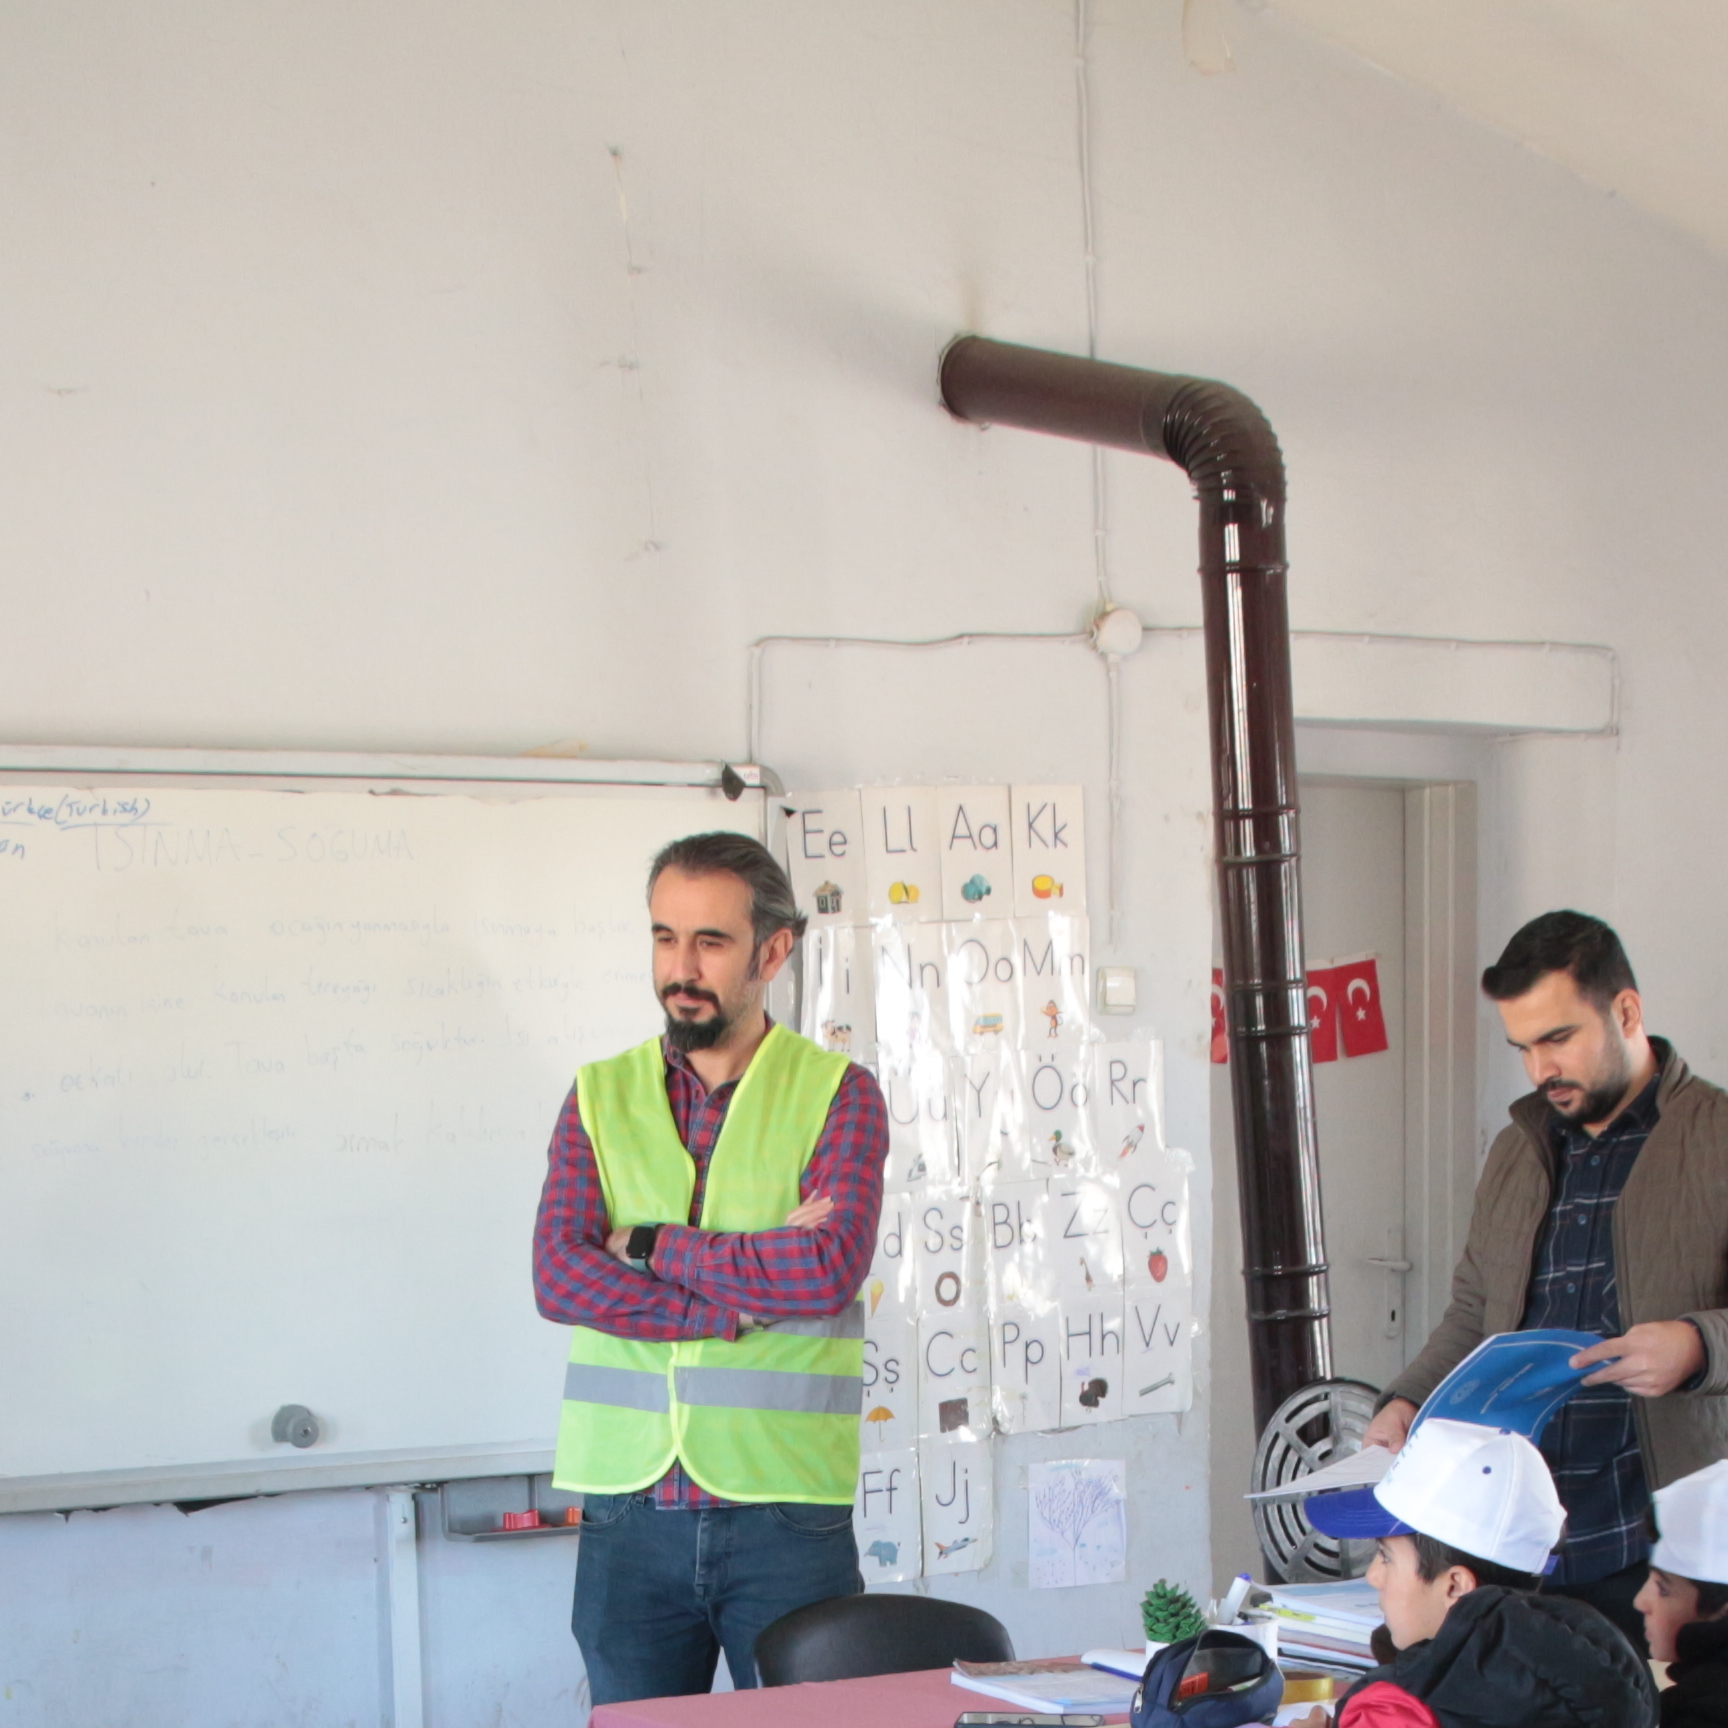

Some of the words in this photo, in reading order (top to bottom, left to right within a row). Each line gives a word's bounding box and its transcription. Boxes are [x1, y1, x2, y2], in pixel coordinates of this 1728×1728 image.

[801, 809, 848, 860] Ee
[882, 804, 918, 855] Ll
[948, 803, 1000, 851] Aa
[1026, 801, 1068, 850] Kk
[1109, 1059, 1148, 1106] Rr
[923, 1207, 965, 1254] Ss
[1127, 1183, 1177, 1239] Çç
[925, 1330, 978, 1378] Cc
[1001, 1321, 1045, 1385] Pp
[1065, 1311, 1121, 1361] Hh
[1135, 1303, 1181, 1348] Vv
[861, 1467, 902, 1518] Ff
[934, 1460, 970, 1525] Jj
